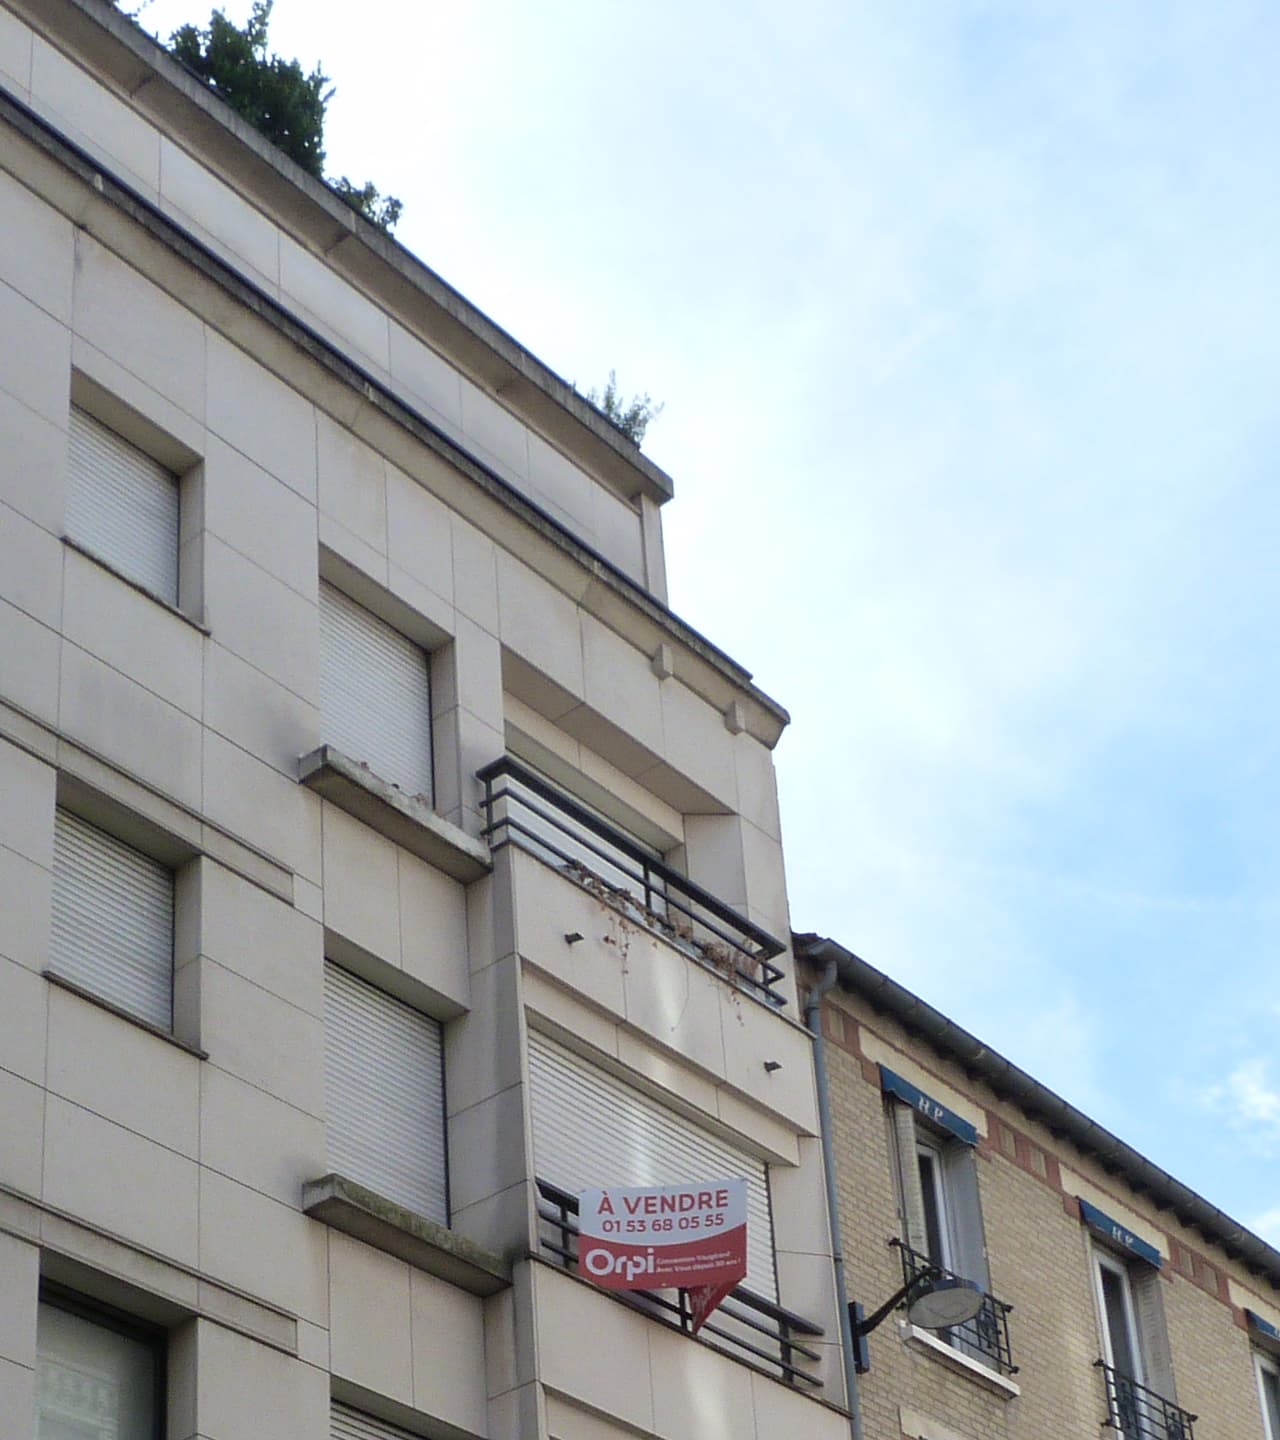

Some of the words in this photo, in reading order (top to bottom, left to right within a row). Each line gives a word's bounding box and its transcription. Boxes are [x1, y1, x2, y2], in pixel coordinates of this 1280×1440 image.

[598, 1191, 614, 1215] À
[623, 1189, 729, 1215] VENDRE
[602, 1220, 621, 1233] 01
[626, 1219, 646, 1232] 53
[651, 1217, 673, 1231] 68
[678, 1215, 699, 1229] 05
[704, 1214, 725, 1227] 55
[585, 1248, 654, 1281] Orpi
